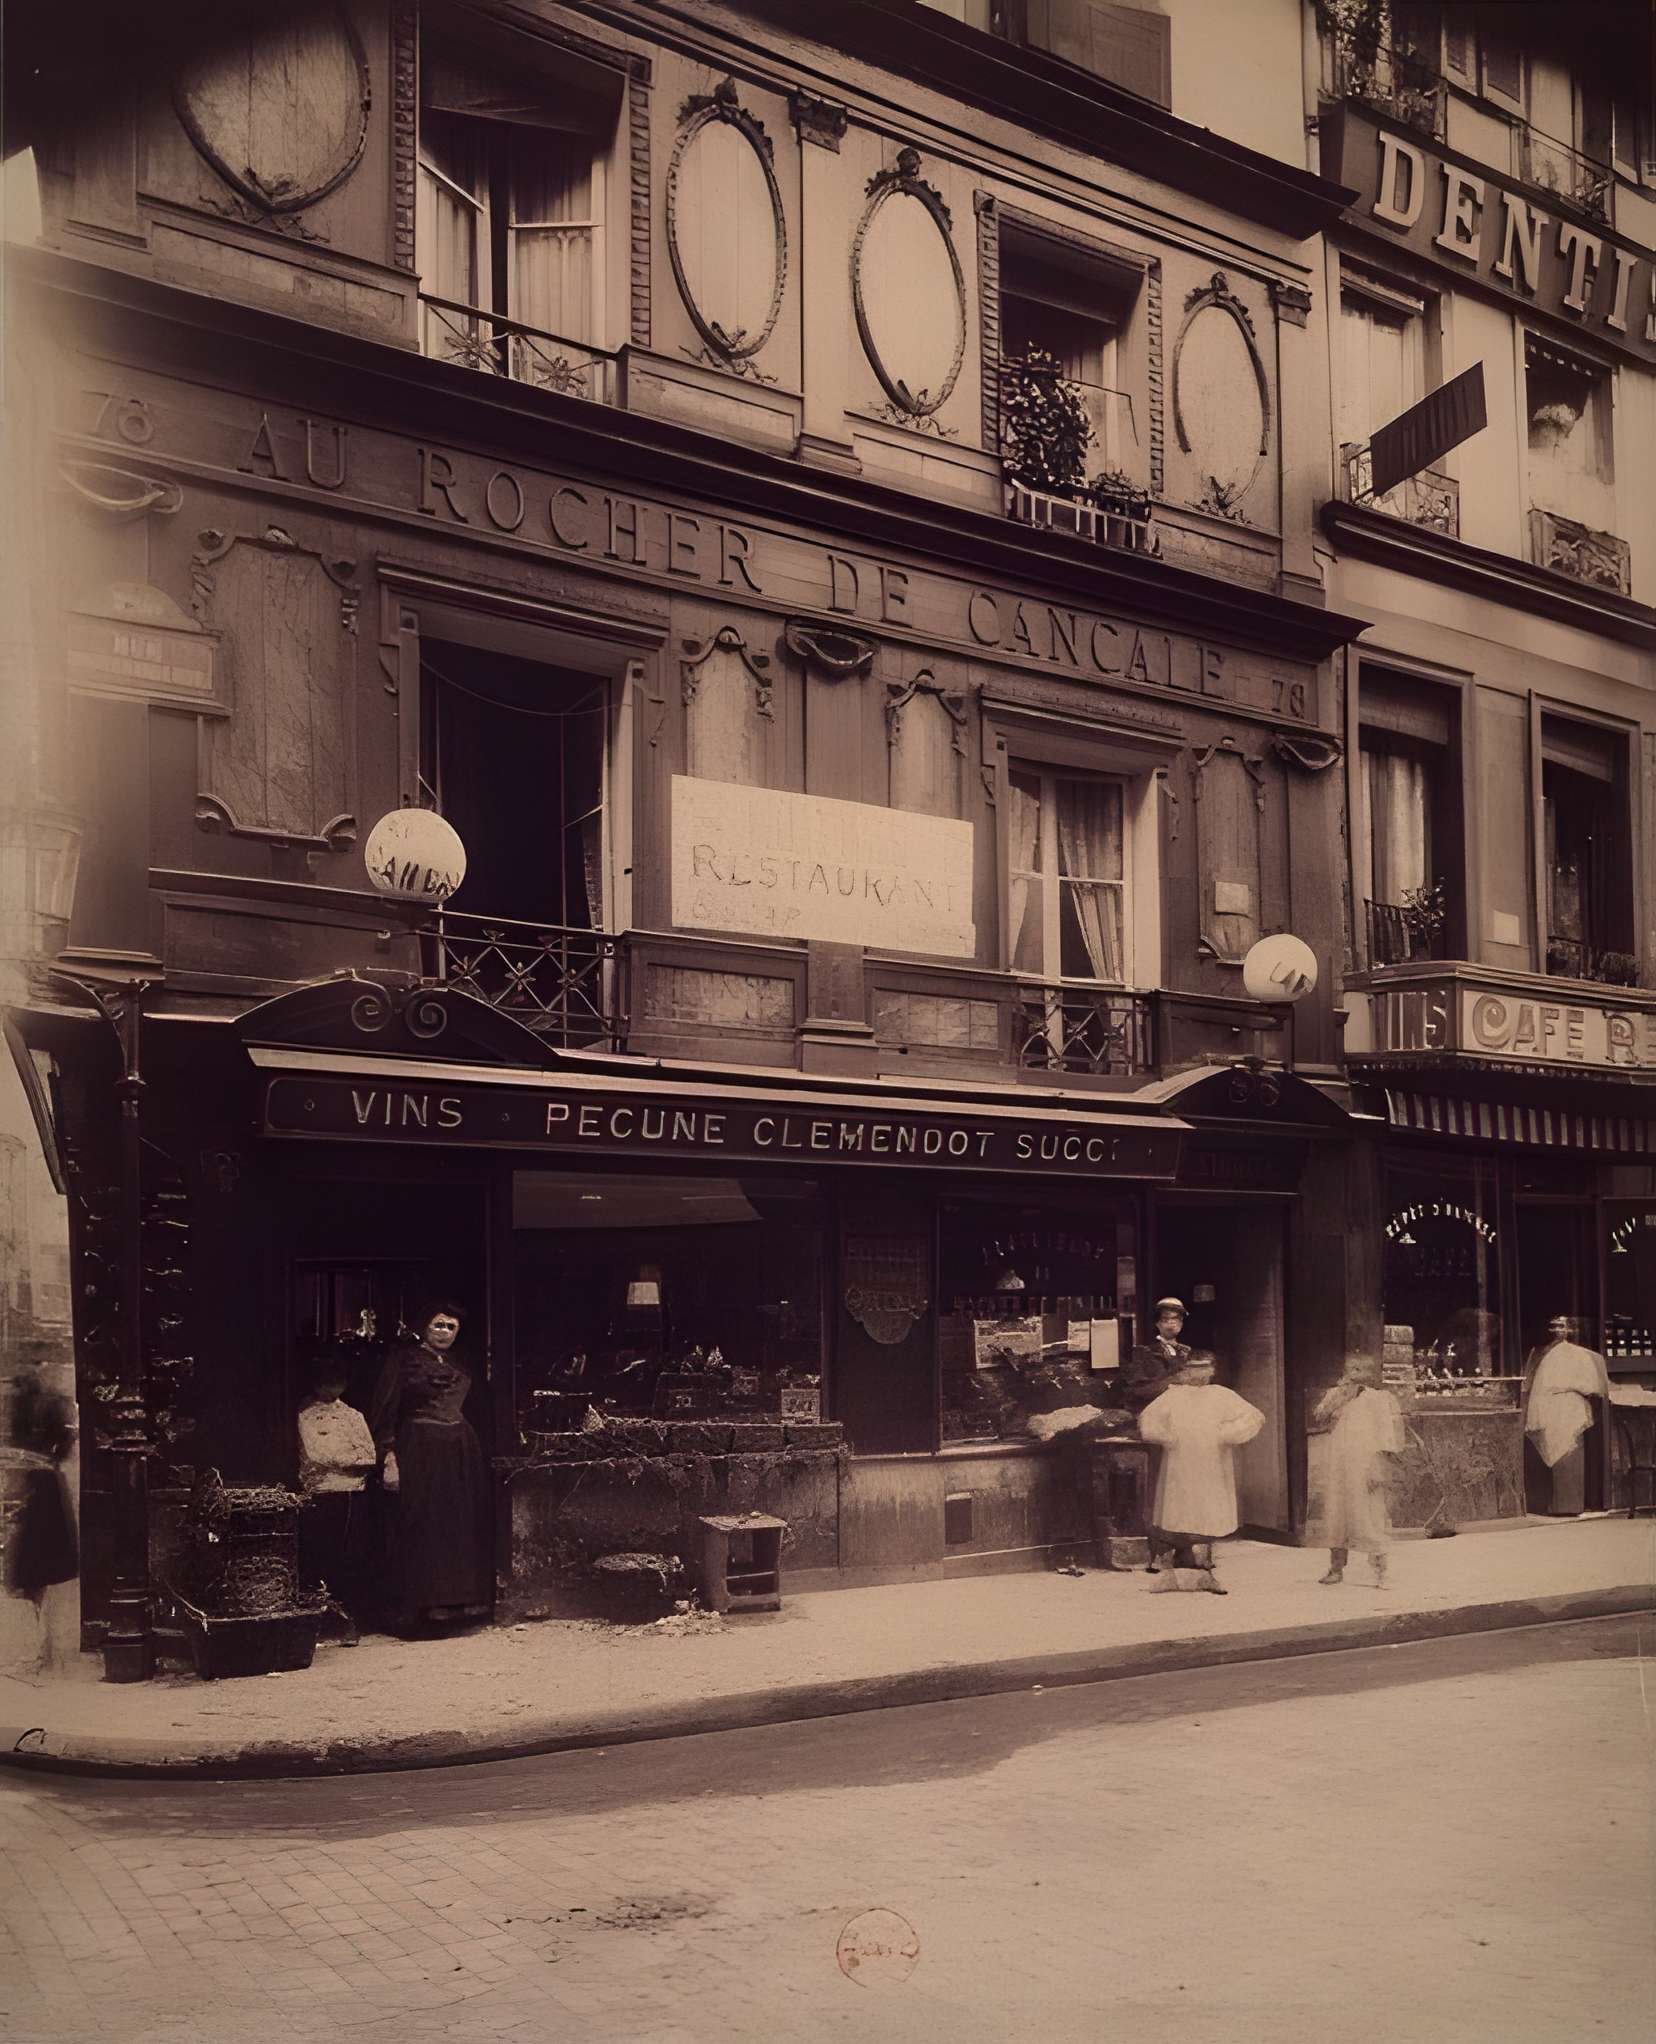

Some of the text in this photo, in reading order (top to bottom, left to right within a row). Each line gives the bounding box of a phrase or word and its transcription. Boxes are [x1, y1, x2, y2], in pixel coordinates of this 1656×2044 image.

[237, 412, 347, 490] AU
[416, 447, 762, 594] ROCHER
[827, 552, 912, 629] DE
[968, 589, 1225, 699] CANCALE
[1271, 679, 1304, 719] 78
[351, 1090, 464, 1128] VINS
[546, 1103, 727, 1144] PECUNE
[753, 1117, 995, 1158] CLEMENDOT
